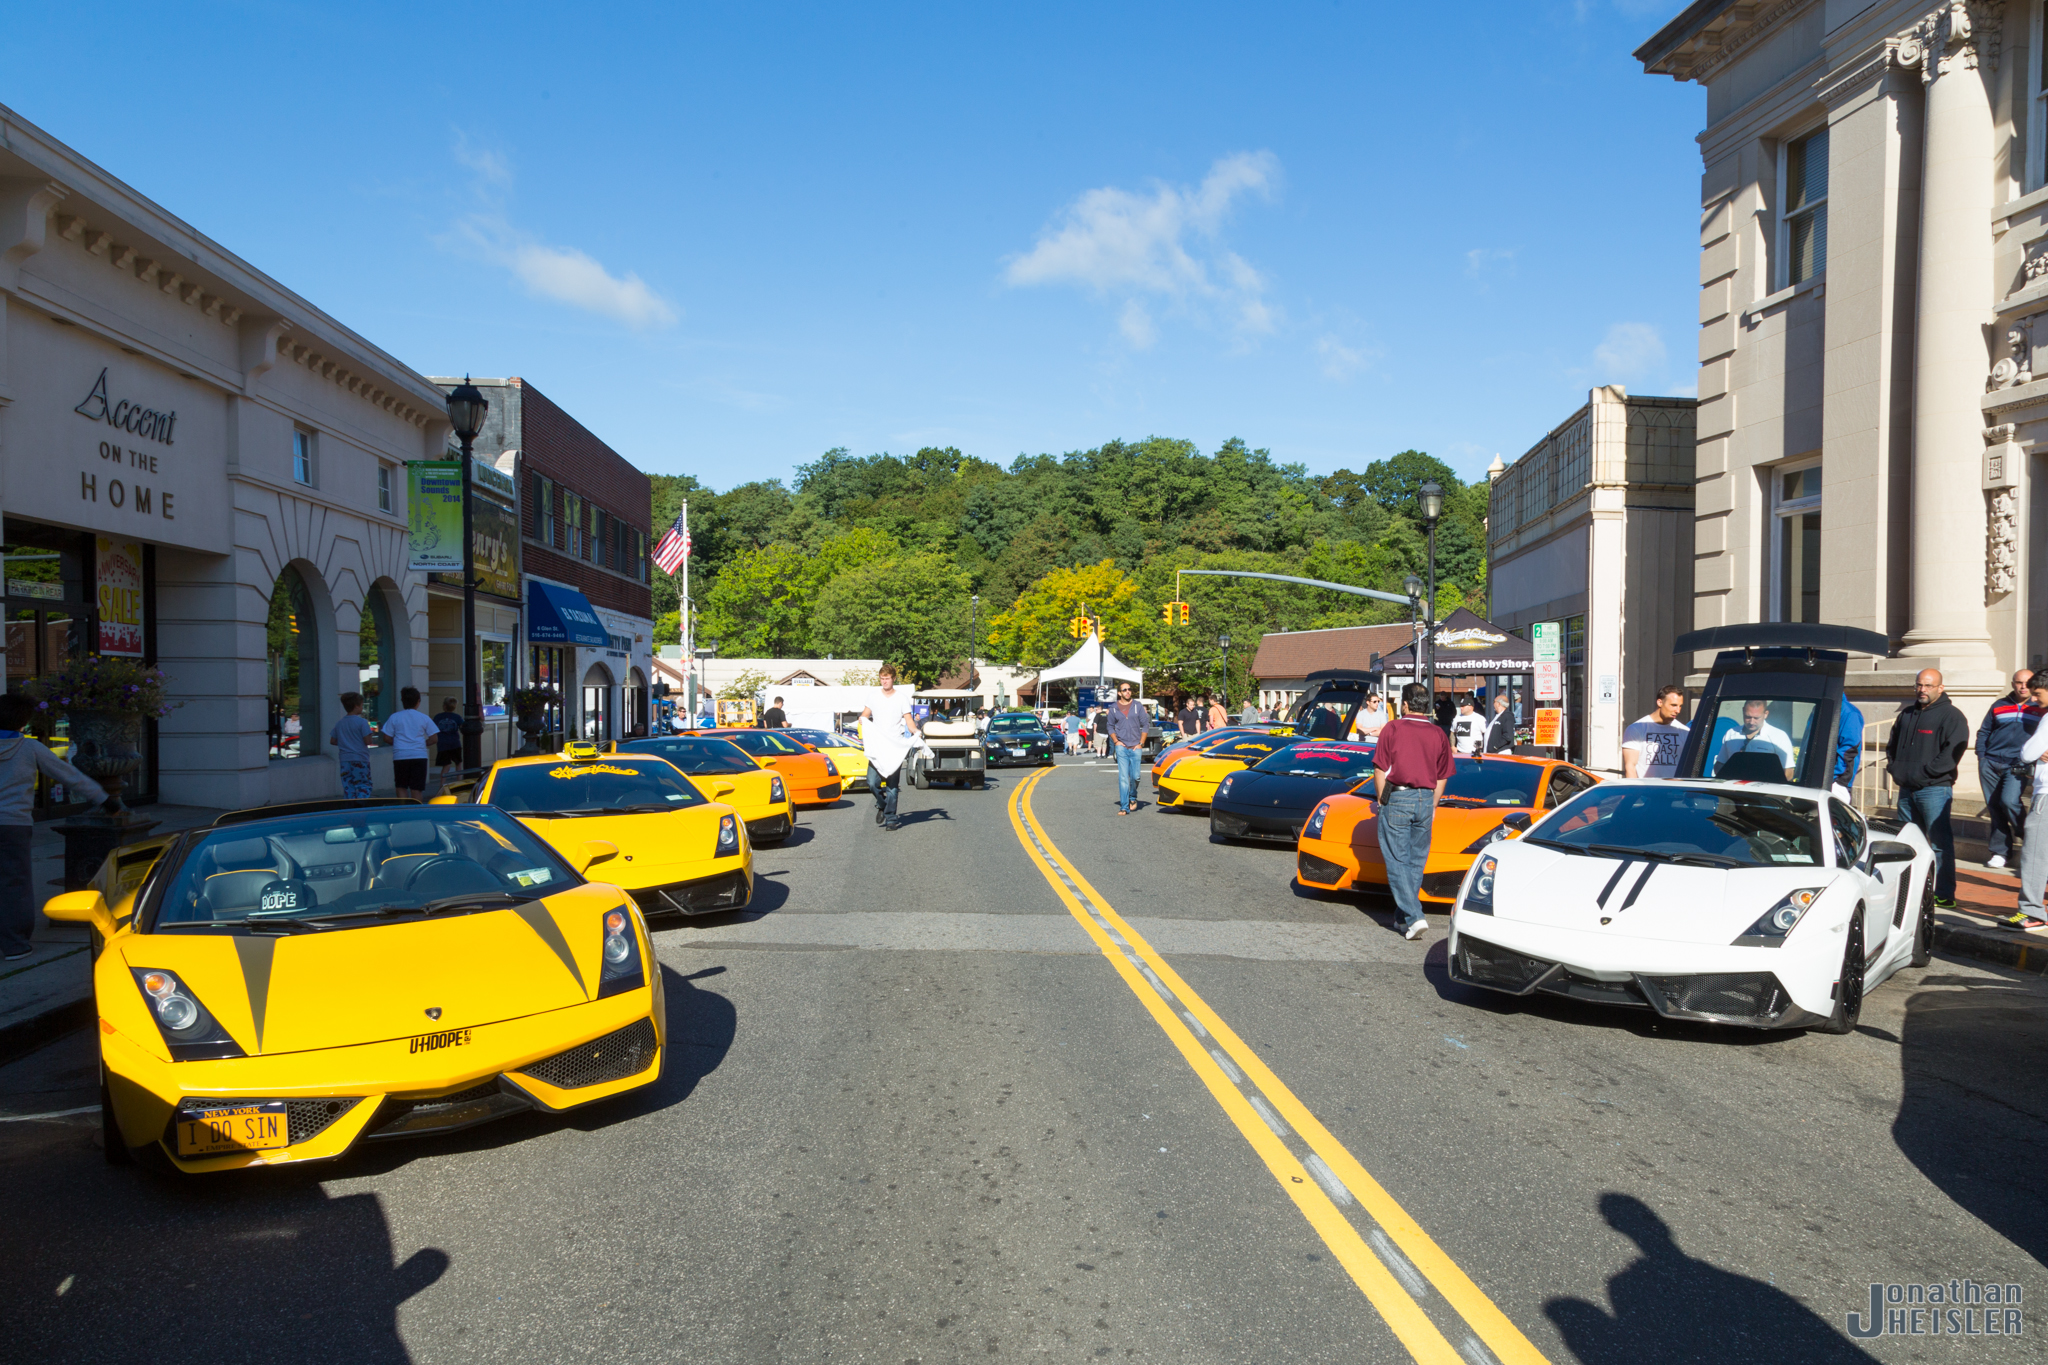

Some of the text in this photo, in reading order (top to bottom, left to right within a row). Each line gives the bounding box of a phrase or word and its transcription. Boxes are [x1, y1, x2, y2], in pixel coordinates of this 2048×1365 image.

[75, 367, 177, 445] Accent
[100, 441, 158, 474] ON THE
[421, 478, 460, 486] Downtown
[81, 471, 174, 520] HOME
[473, 531, 508, 571] nry's
[98, 554, 140, 588] ANNIVERSARY
[12, 582, 62, 597] PARKING IN REAR
[98, 584, 140, 625] SALE
[1536, 627, 1542, 637] 2
[1646, 733, 1680, 744] EAST
[1646, 744, 1680, 754] COAST
[1646, 754, 1678, 764] RALLY
[262, 893, 297, 910] DOPE
[204, 1106, 261, 1118] NEW YORK
[189, 1116, 278, 1145] I DO SIN
